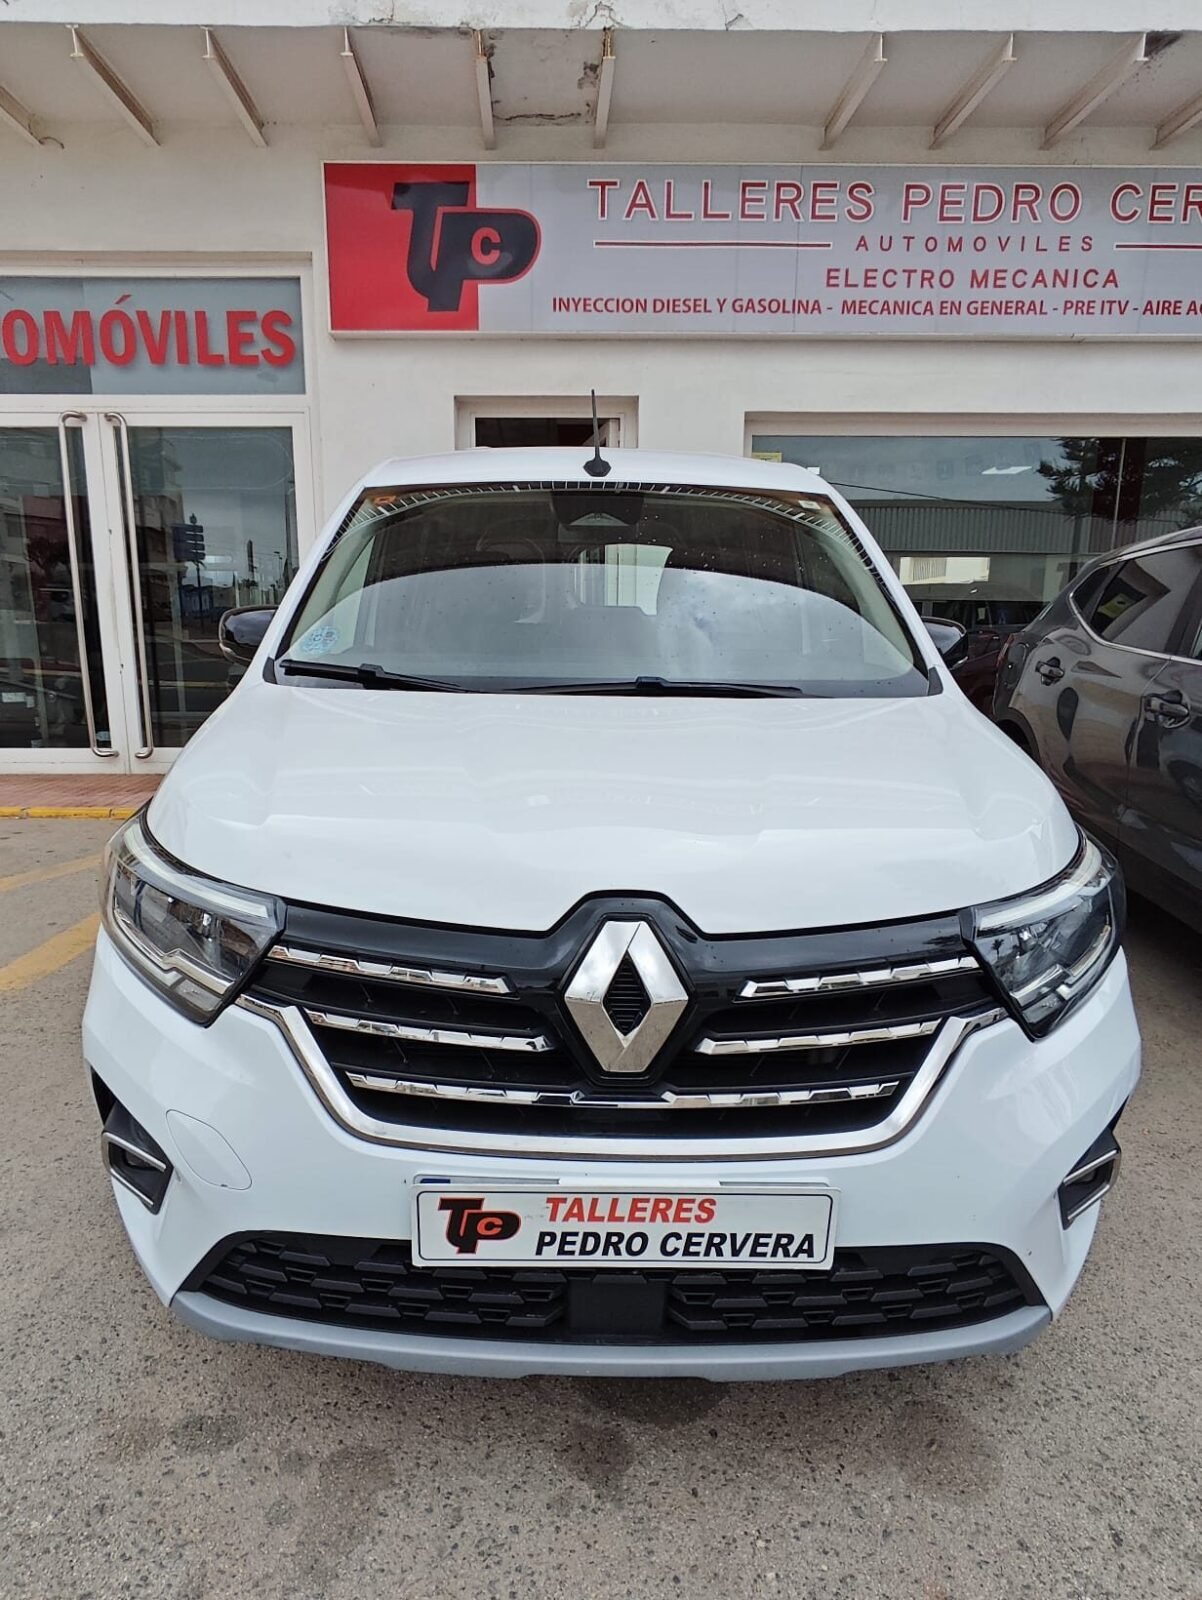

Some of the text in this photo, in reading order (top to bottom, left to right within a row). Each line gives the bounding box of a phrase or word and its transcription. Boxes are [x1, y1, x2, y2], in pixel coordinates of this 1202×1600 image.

[587, 178, 1202, 224] TALLERES PEDRO CER
[856, 236, 1094, 252] AUTOMOVILES
[825, 268, 1120, 289] ELECTRO MECANICA
[552, 297, 648, 313] INYECCION
[652, 298, 712, 314] DIESEL
[716, 298, 727, 313] Y
[731, 298, 822, 315] GASOLINA
[841, 299, 934, 315] MECANICA
[939, 300, 962, 315] EN
[966, 300, 1048, 316] GENERAL
[1063, 300, 1096, 316] PRE
[1100, 300, 1129, 316] ITV
[1142, 300, 1183, 316] AIRE
[1186, 300, 1202, 316] A
[1, 294, 297, 367] OMÓVILES
[545, 1196, 717, 1224] TALLERES
[535, 1231, 815, 1259] PEDRO CERVERA
